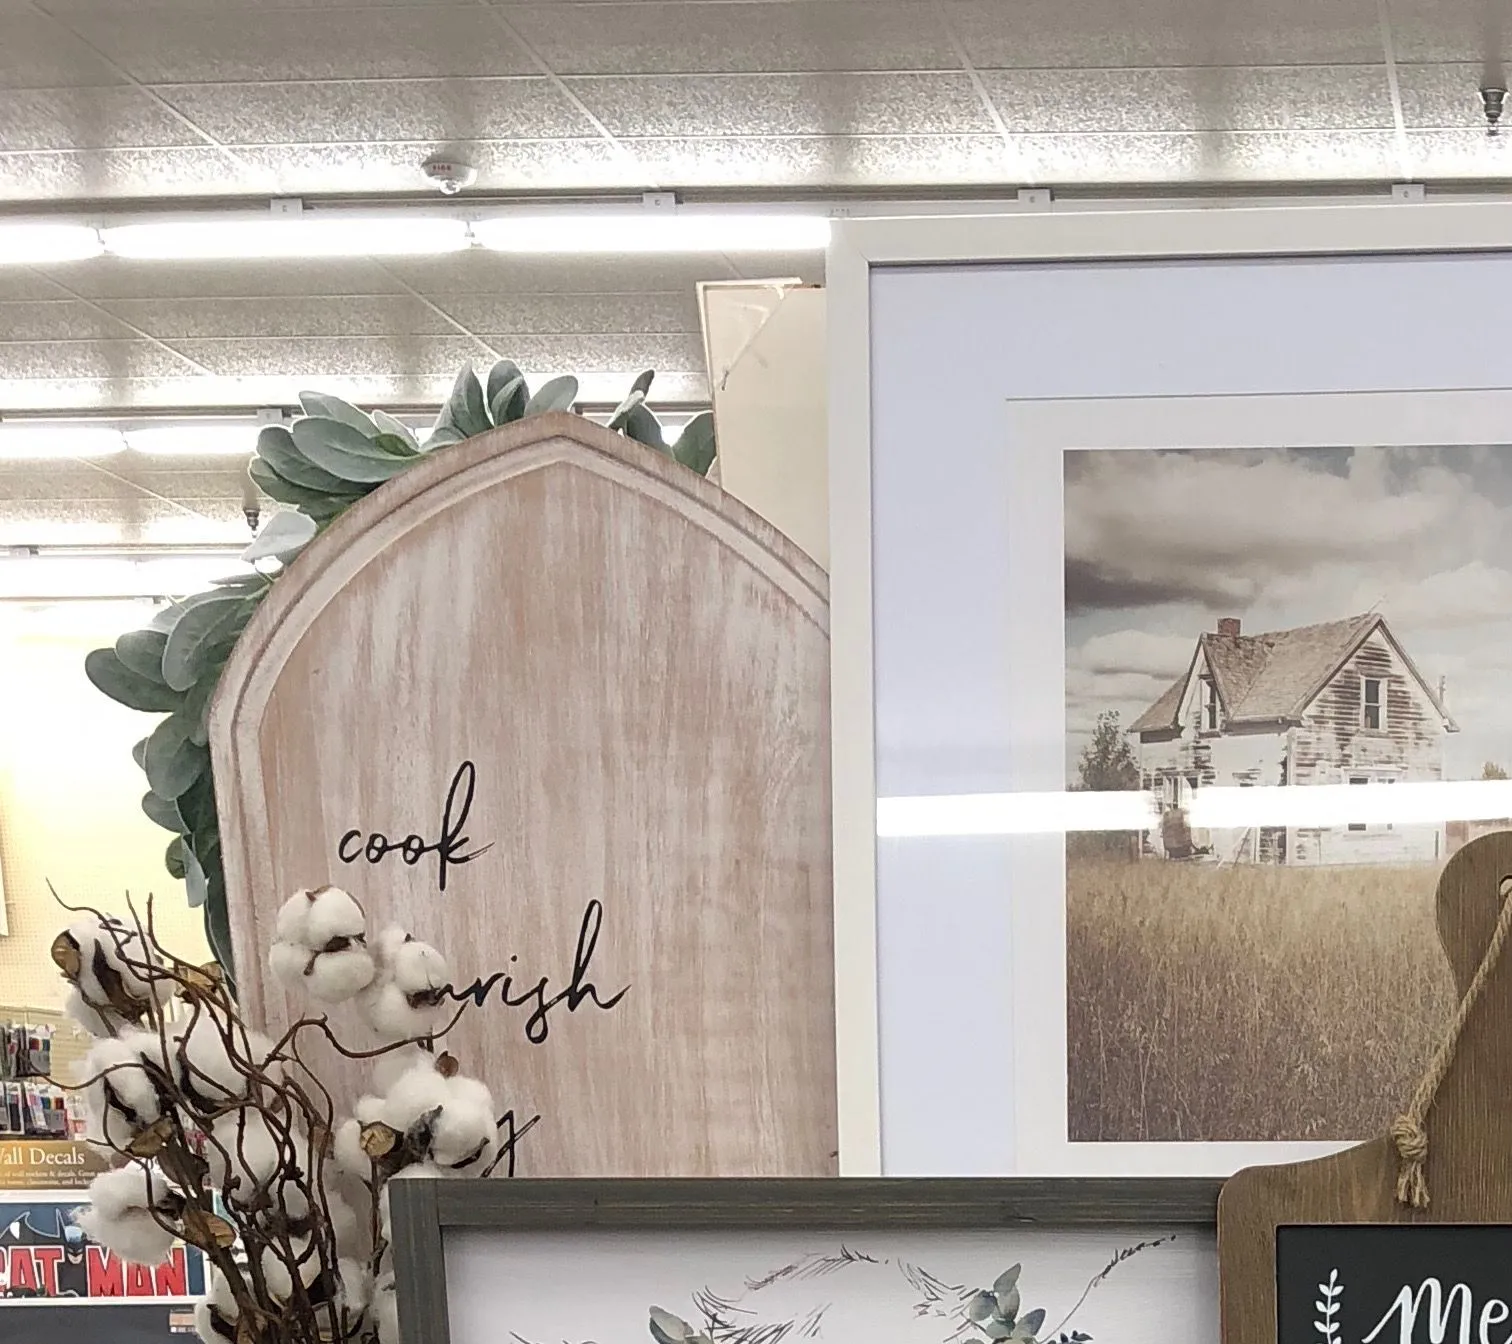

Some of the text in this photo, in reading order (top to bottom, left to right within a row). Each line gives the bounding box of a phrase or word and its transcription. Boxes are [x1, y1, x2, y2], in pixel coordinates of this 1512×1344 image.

[338, 760, 496, 892] cook
[430, 899, 633, 1045] rish
[28, 1146, 85, 1165] Decals
